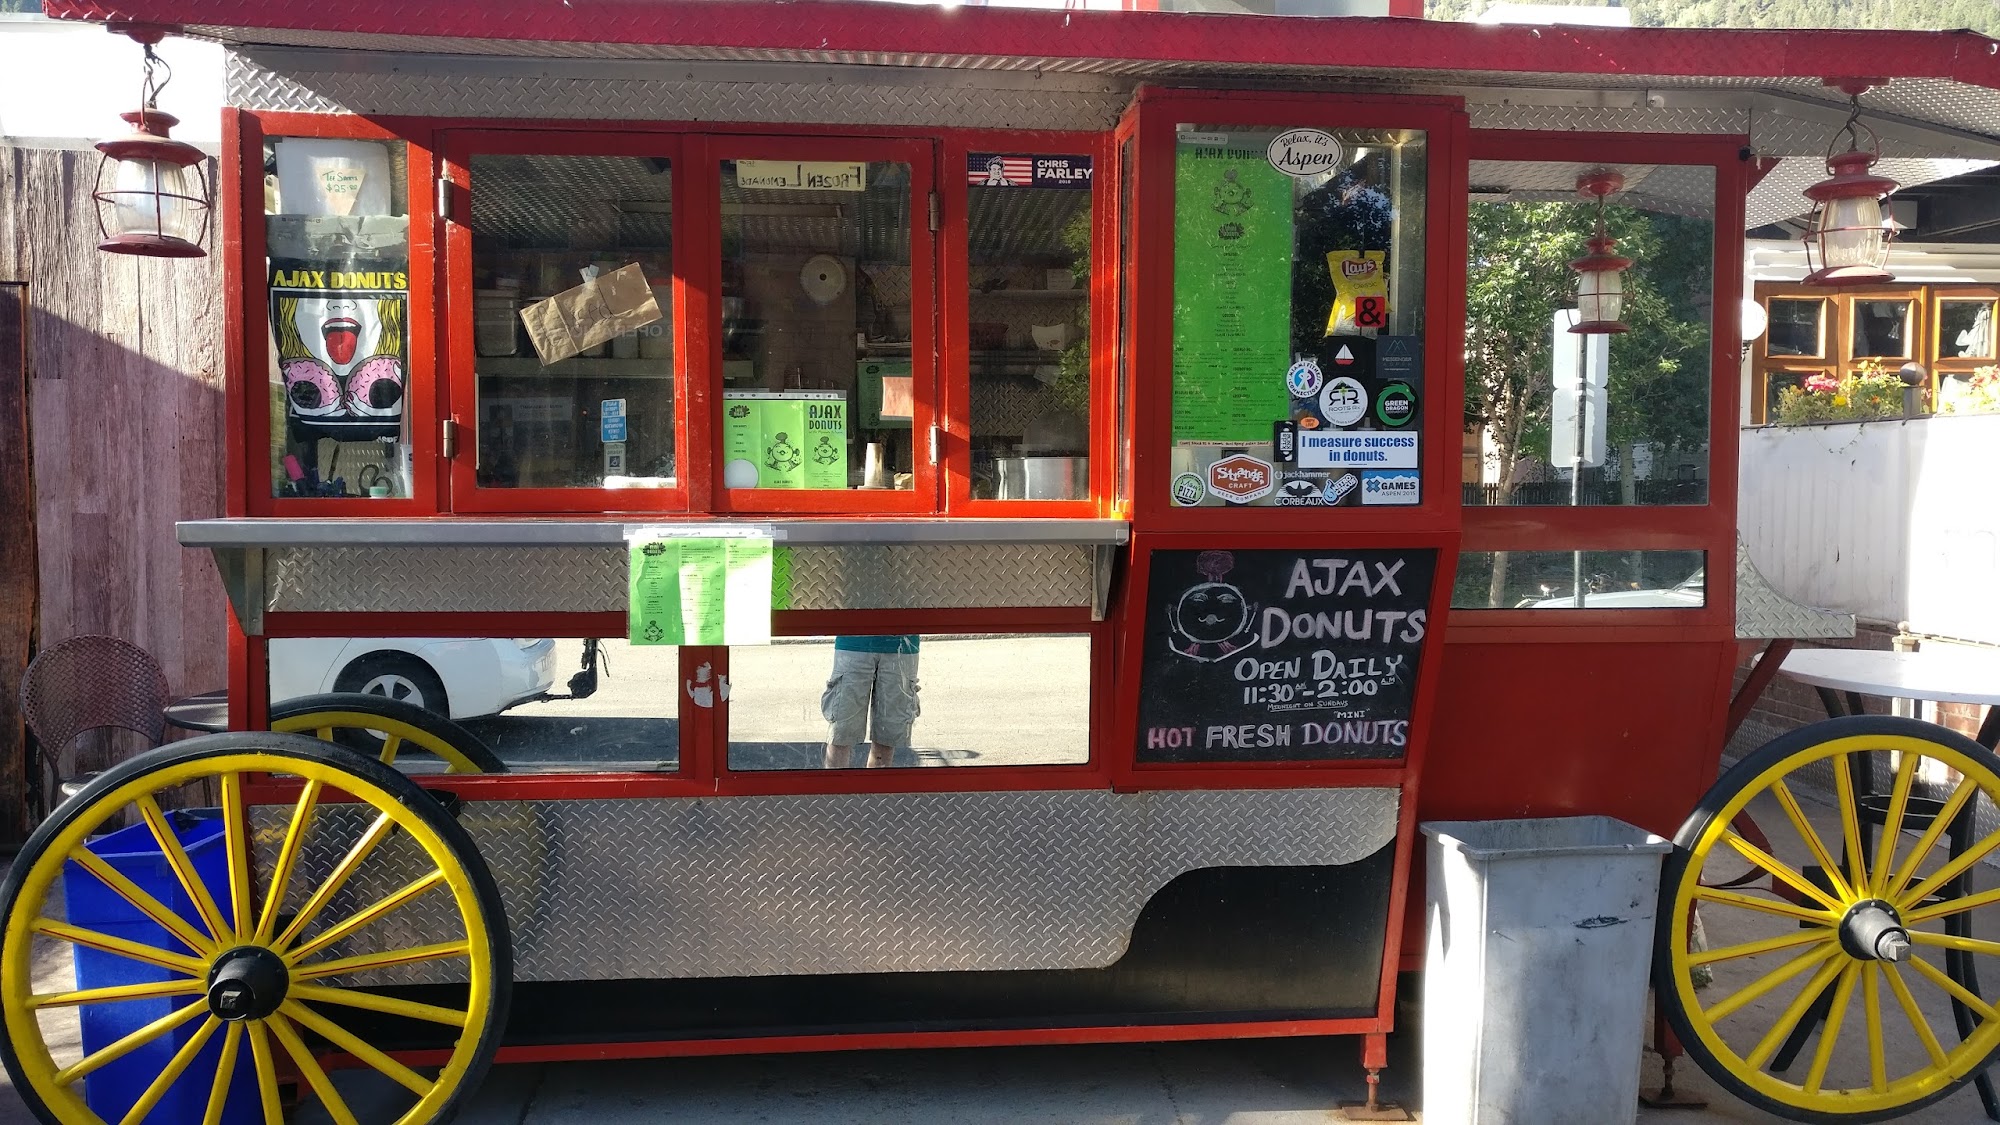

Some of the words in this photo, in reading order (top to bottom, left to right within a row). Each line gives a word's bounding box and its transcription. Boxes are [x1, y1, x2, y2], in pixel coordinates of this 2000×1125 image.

[1280, 134, 1312, 148] Relax,
[1314, 135, 1329, 147] it's
[1037, 160, 1069, 168] CHRIS
[1279, 146, 1334, 171] Aspen
[1037, 168, 1093, 179] FARLEY
[273, 270, 325, 288] AJAX
[1359, 298, 1382, 326] &
[1288, 381, 1319, 397] CONNECTION
[1384, 399, 1409, 407] GREEN
[809, 404, 842, 419] AJAX
[809, 420, 842, 430] DONUTS
[1301, 435, 1306, 448] I
[1308, 437, 1362, 448] measure
[1364, 437, 1415, 448] success
[1328, 450, 1341, 462] in
[1343, 450, 1388, 462] donuts.
[1216, 467, 1264, 483] Strange
[1283, 470, 1331, 479] jackhammer
[1381, 481, 1416, 490] GAMES
[1177, 486, 1197, 499] PIZZA
[1217, 490, 1233, 499] BEER
[1235, 489, 1266, 501] COMPANY
[1274, 497, 1325, 506] CORBEAUX
[1285, 558, 1406, 598] AJAX
[1260, 607, 1427, 649] DONUTS
[1234, 657, 1301, 681] OPEN
[1311, 650, 1403, 681] DAILY
[1243, 683, 1295, 705] 11:30
[1267, 703, 1302, 712] MIDNIGHT
[1317, 700, 1349, 708] SUNDAYS
[1148, 727, 1196, 749] HOT
[1205, 724, 1291, 749] FRESH
[1301, 720, 1409, 747] DONUTS
